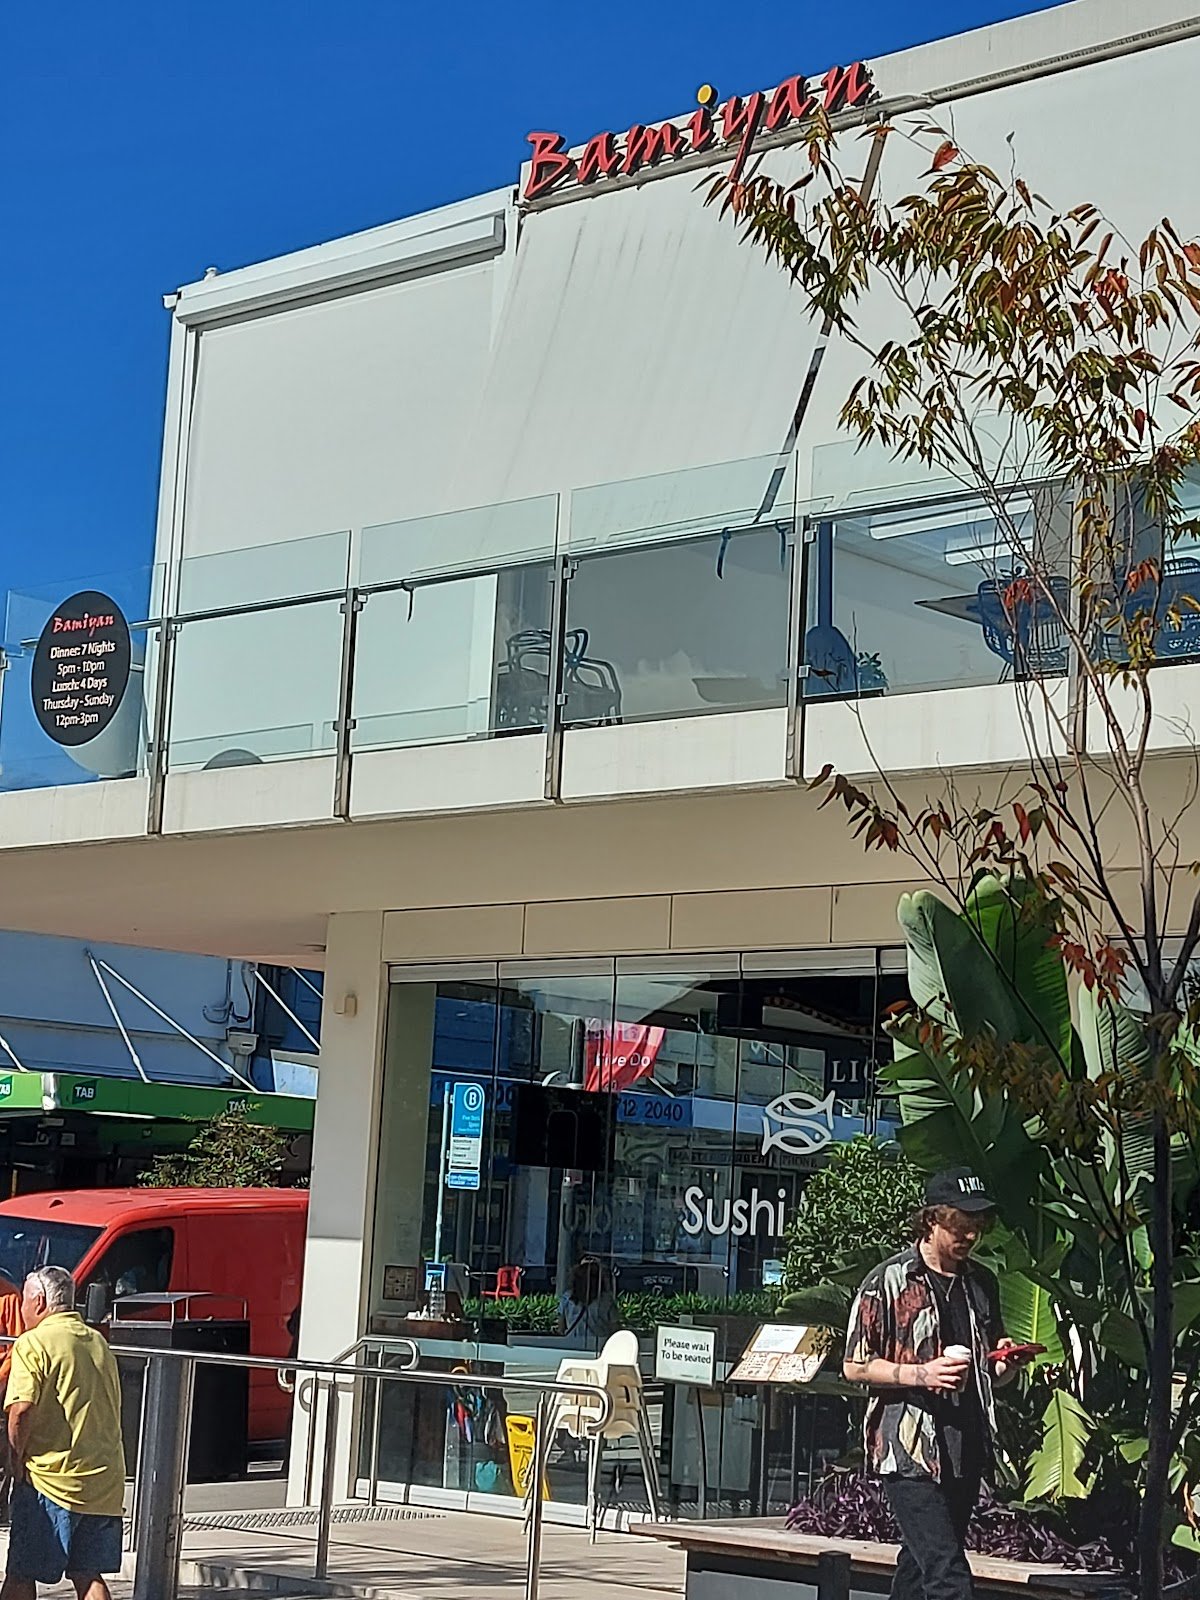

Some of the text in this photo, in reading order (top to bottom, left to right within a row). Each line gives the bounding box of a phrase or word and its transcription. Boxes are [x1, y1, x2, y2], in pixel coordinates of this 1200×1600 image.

[524, 61, 875, 200] Bamiyan
[53, 612, 114, 638] Bamiyan
[81, 643, 88, 656] 7
[88, 640, 116, 657] Nights
[56, 663, 76, 678] 5pm
[80, 678, 87, 689] 4
[87, 676, 108, 691] Days
[43, 694, 79, 711] Thursday
[84, 692, 115, 707] Sunday
[75, 1086, 95, 1099] TAB
[468, 1091, 477, 1106] B
[644, 1100, 683, 1121] 2040
[682, 1185, 786, 1237] Sushi
[664, 1338, 710, 1352] Please wait
[661, 1349, 712, 1365] To be seated
